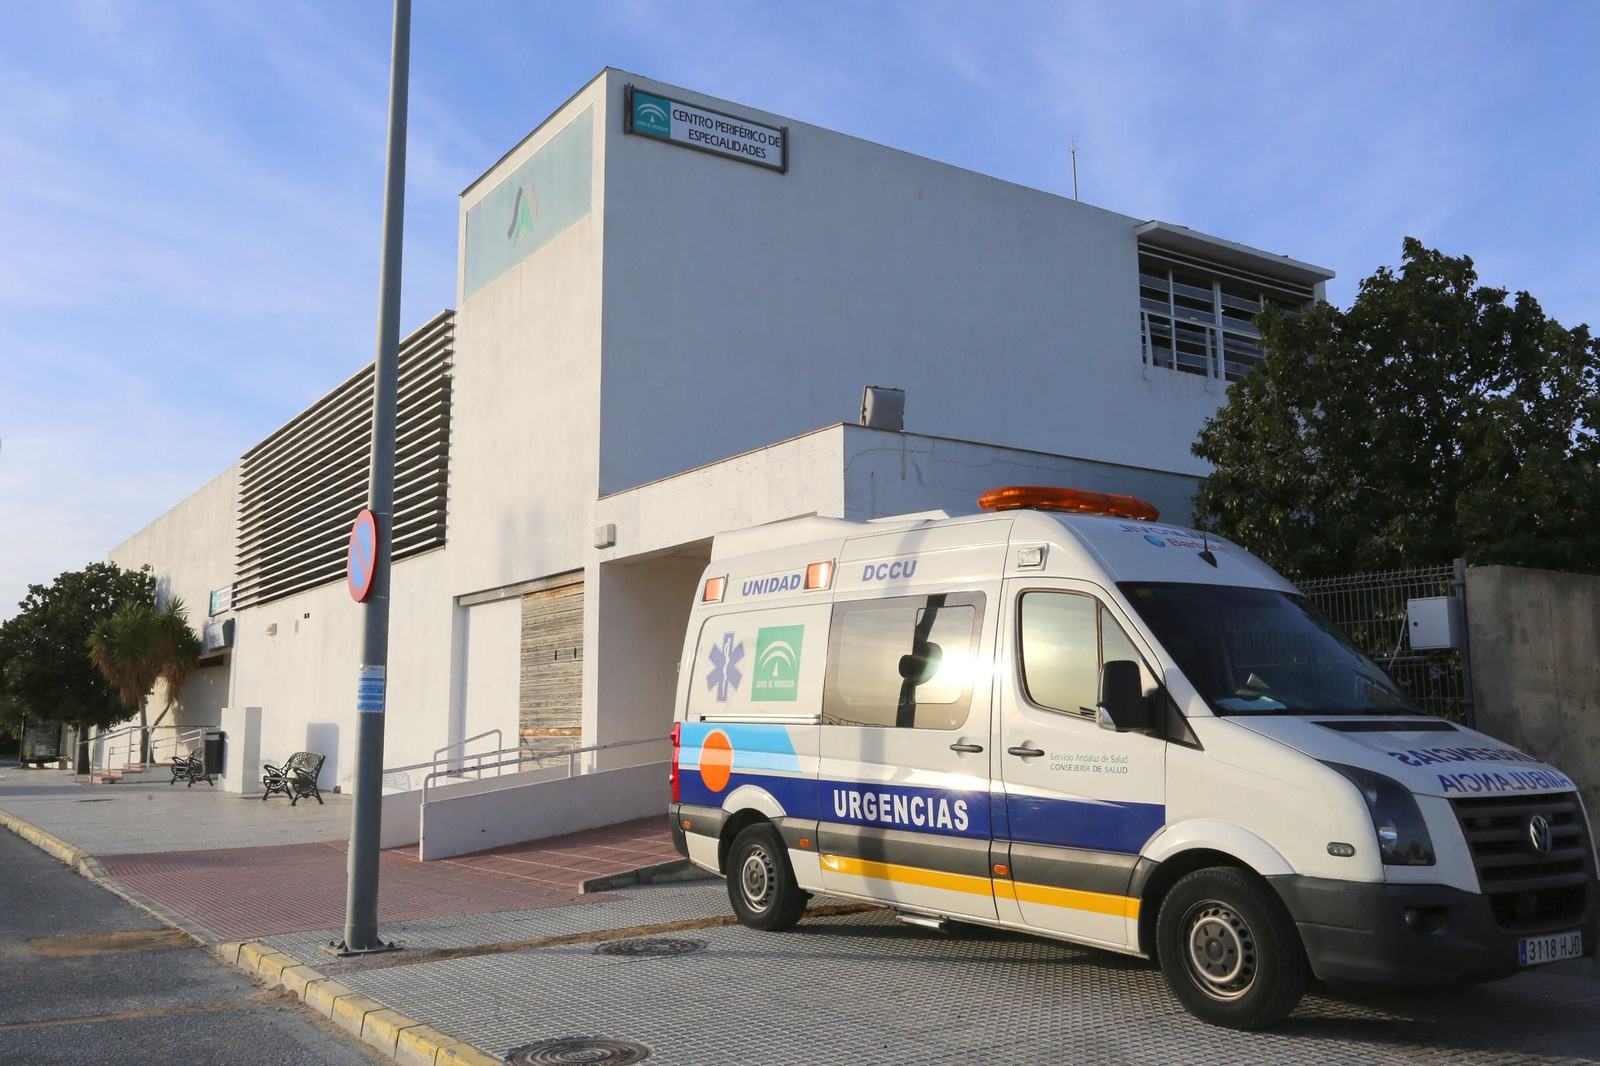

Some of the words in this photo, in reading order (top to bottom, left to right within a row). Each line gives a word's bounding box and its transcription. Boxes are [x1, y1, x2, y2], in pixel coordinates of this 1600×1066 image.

[672, 109, 714, 130] CENTRO
[715, 121, 767, 144] PERIFÉRICO
[768, 135, 781, 148] DE
[688, 128, 766, 159] ESPECIALIDADES
[861, 560, 917, 582] DCCU
[741, 574, 801, 597] UNIDAD
[1050, 752, 1074, 762] Servicio
[1075, 753, 1100, 763] Andaluz
[1101, 754, 1109, 763] de
[1110, 755, 1128, 764] Salud
[1050, 763, 1090, 773] CONSEJERÍA
[1092, 765, 1102, 773] DE
[1105, 765, 1128, 774] SALUD
[833, 789, 969, 831] URGENCIAS
[1529, 938, 1557, 961] 3118
[1560, 935, 1580, 957] HJD
